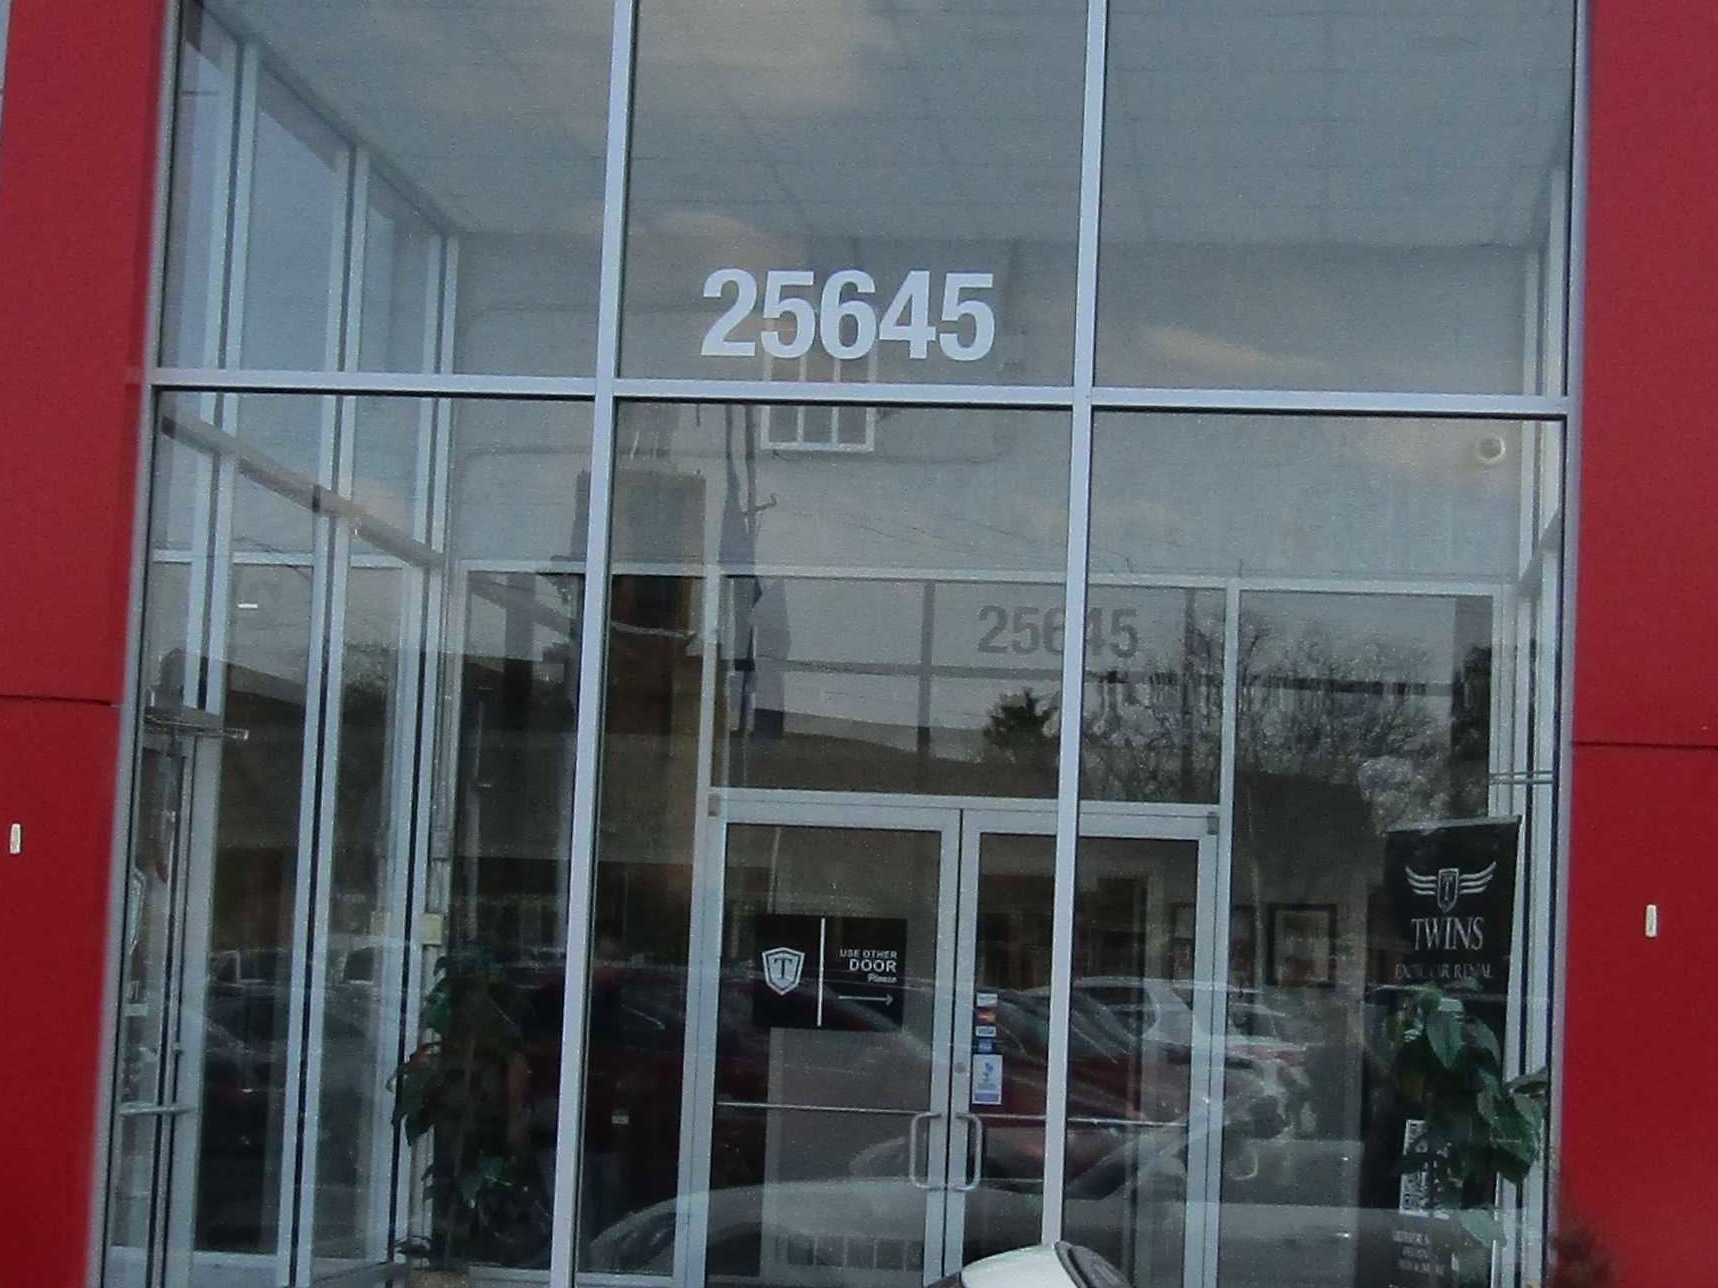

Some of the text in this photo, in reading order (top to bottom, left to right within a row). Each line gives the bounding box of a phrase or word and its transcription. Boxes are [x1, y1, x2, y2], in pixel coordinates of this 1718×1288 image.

[700, 267, 996, 362] 25645
[1411, 916, 1484, 951] TWINS
[849, 958, 897, 973] DOOR
[862, 949, 898, 960] OTHER
